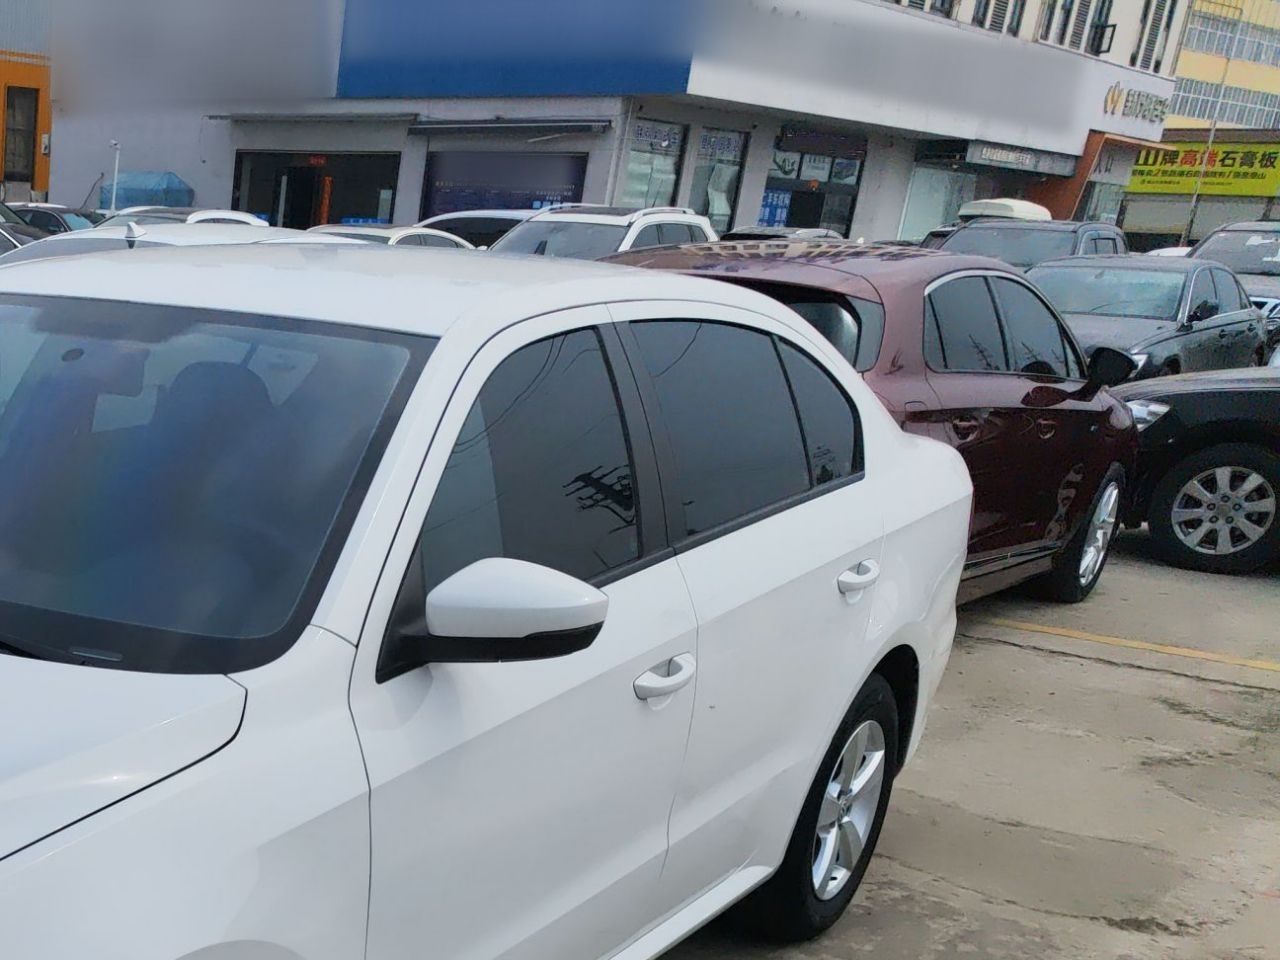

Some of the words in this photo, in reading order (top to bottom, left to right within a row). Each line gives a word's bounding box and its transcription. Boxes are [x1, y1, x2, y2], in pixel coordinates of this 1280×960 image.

[1134, 149, 1279, 169] 山牌高端石膏板
